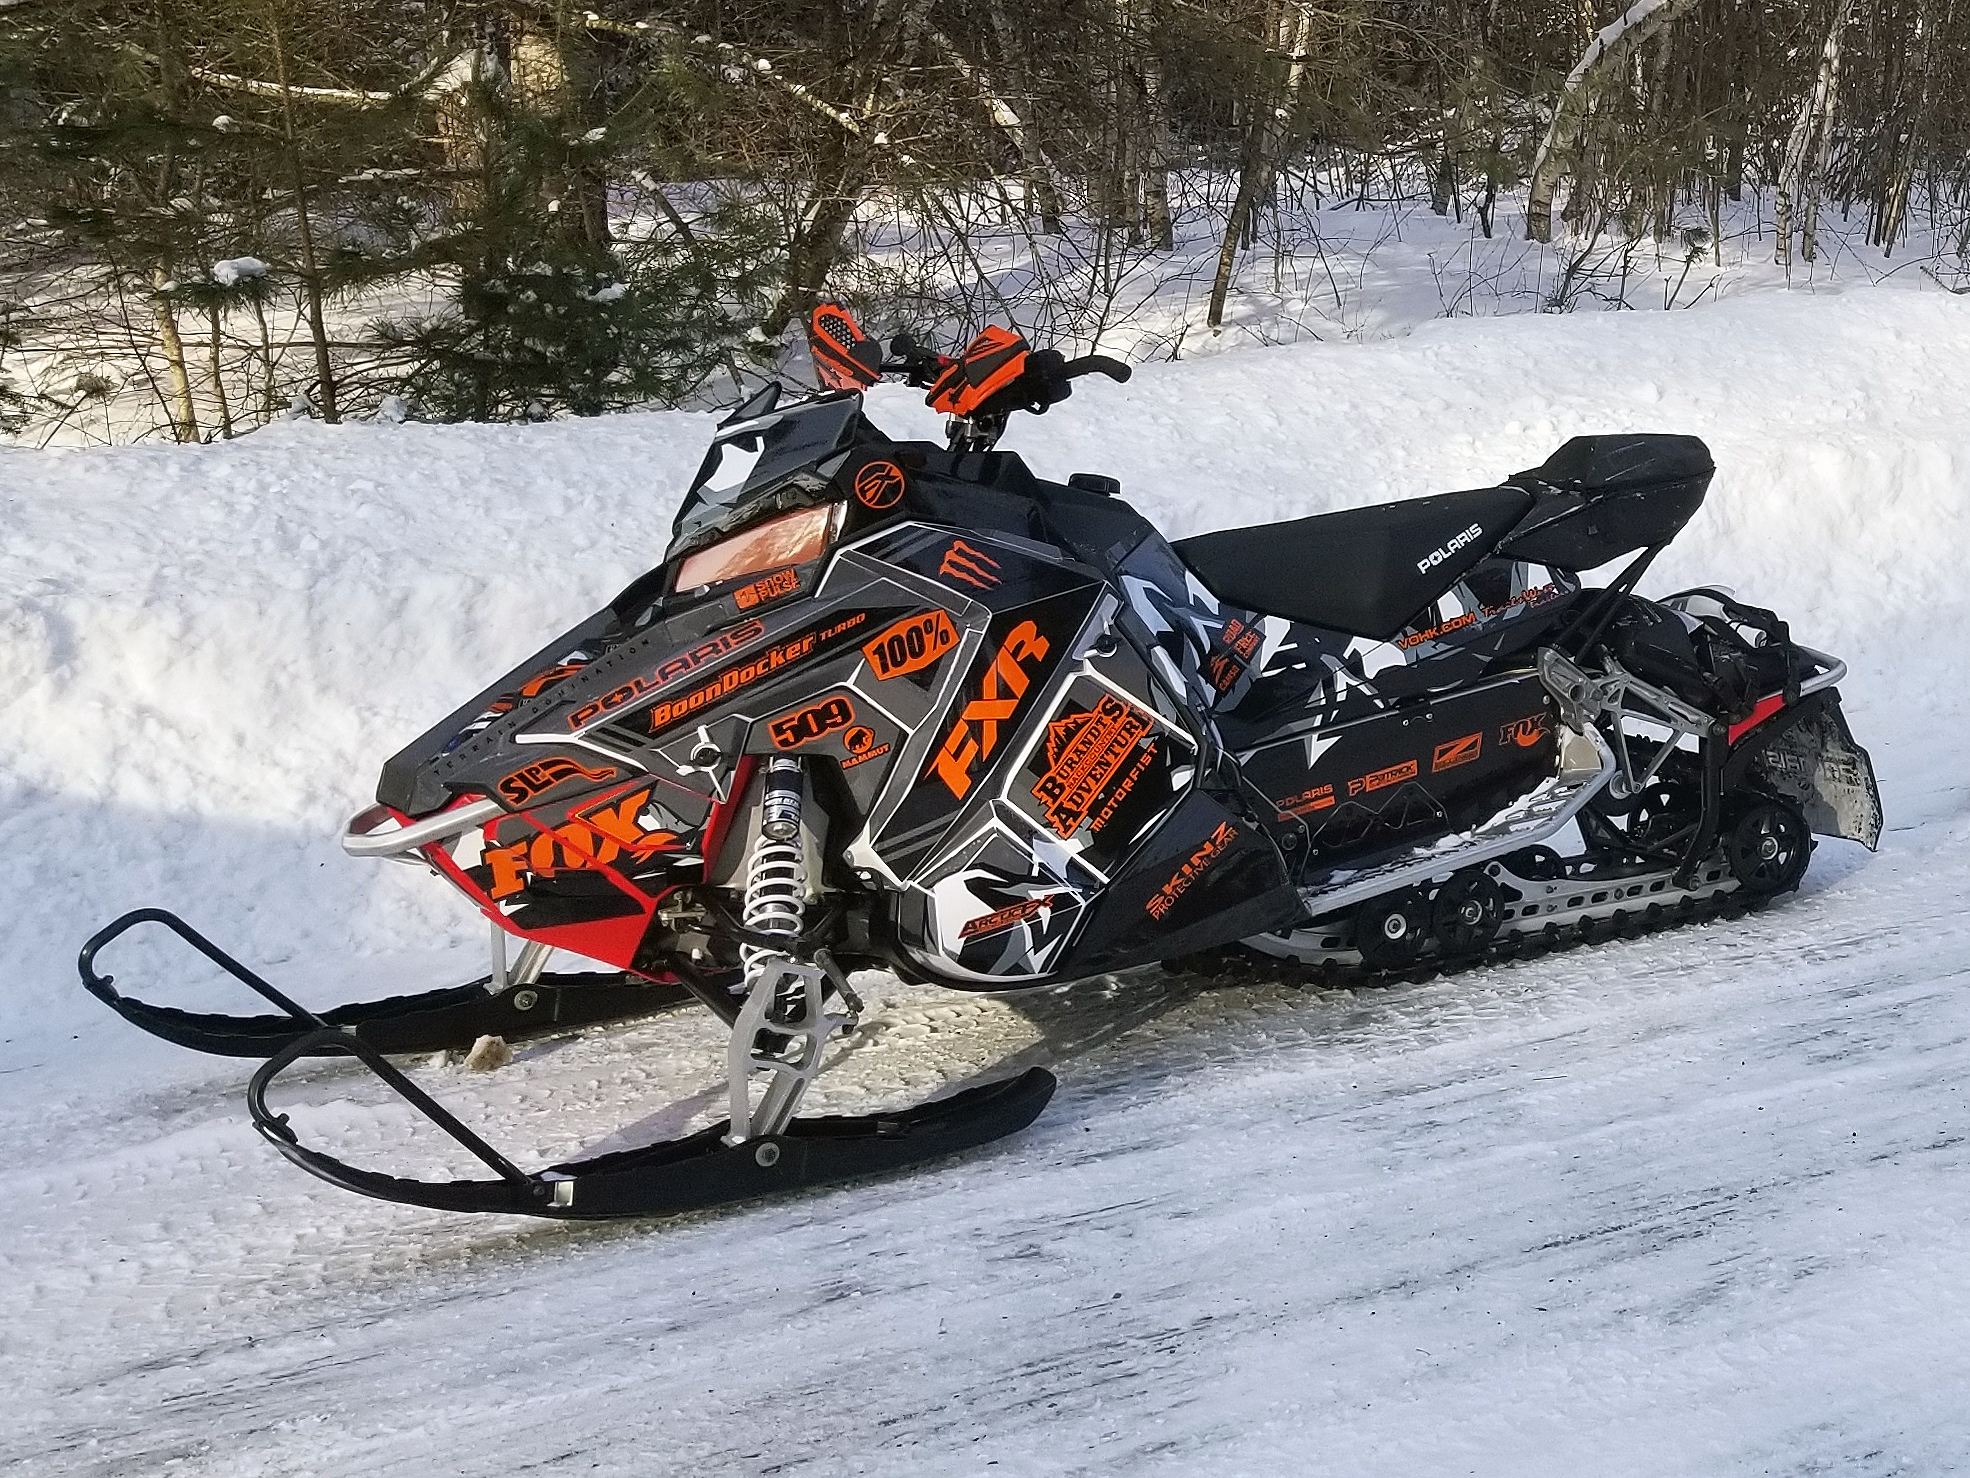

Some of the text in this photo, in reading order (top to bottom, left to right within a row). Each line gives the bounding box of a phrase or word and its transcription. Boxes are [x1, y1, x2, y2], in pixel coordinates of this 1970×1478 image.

[1416, 523, 1483, 574] POLARIS
[567, 619, 766, 731] POLARIS
[649, 631, 818, 732] BoonDocker
[871, 614, 951, 674] 100%
[769, 697, 855, 750] 509
[924, 620, 1050, 800] FXR
[1499, 712, 1550, 746] FOX
[841, 743, 890, 770] MAMMUT
[1090, 743, 1158, 831] MOTORFIST
[1274, 784, 1334, 808] POLARIS
[484, 788, 674, 900] FOX
[1145, 821, 1227, 914] SKINZ
[1151, 826, 1239, 920] PROTECTIVE GEAR
